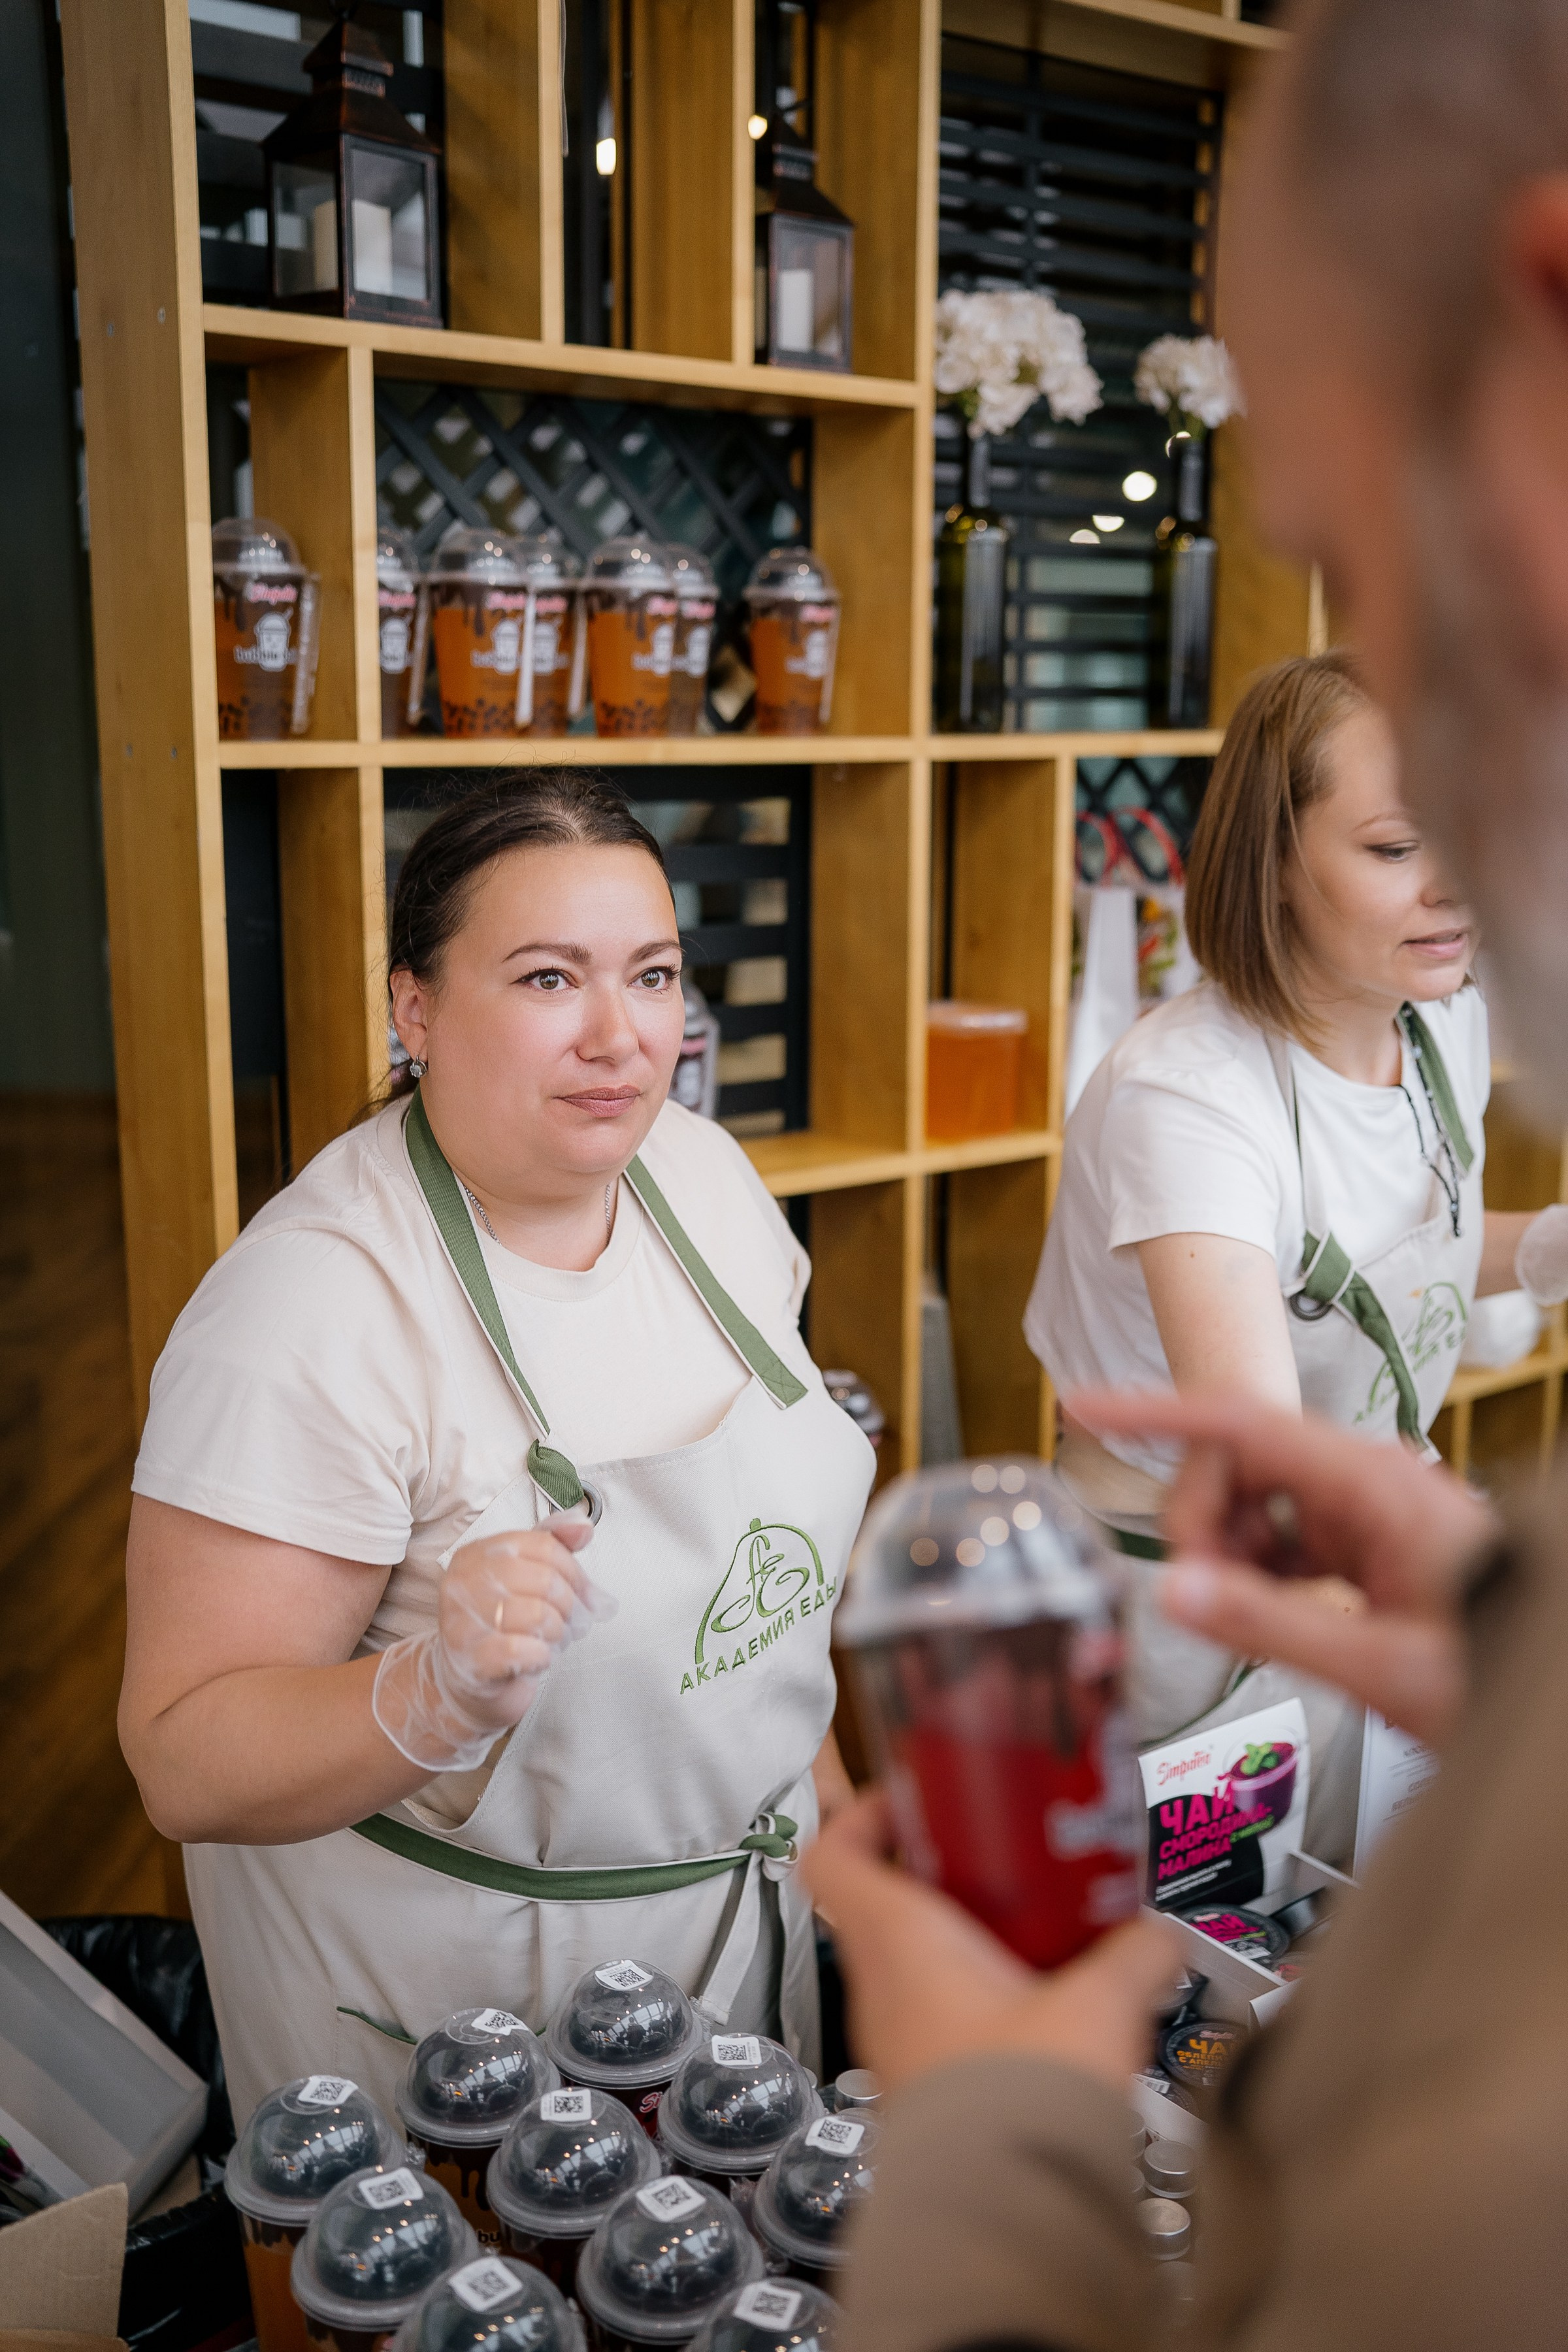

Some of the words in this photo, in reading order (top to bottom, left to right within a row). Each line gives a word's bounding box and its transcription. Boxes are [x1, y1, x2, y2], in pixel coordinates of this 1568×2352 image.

[679, 1607, 796, 1695] АКАДЕМИЯ
[800, 1576, 838, 1618] ЕДЫ
[1157, 1837, 1233, 1881] МАЛИНА
[1176, 2050, 1224, 2061] ОБЛЕПИ
[1188, 2038, 1234, 2056] ЧА
